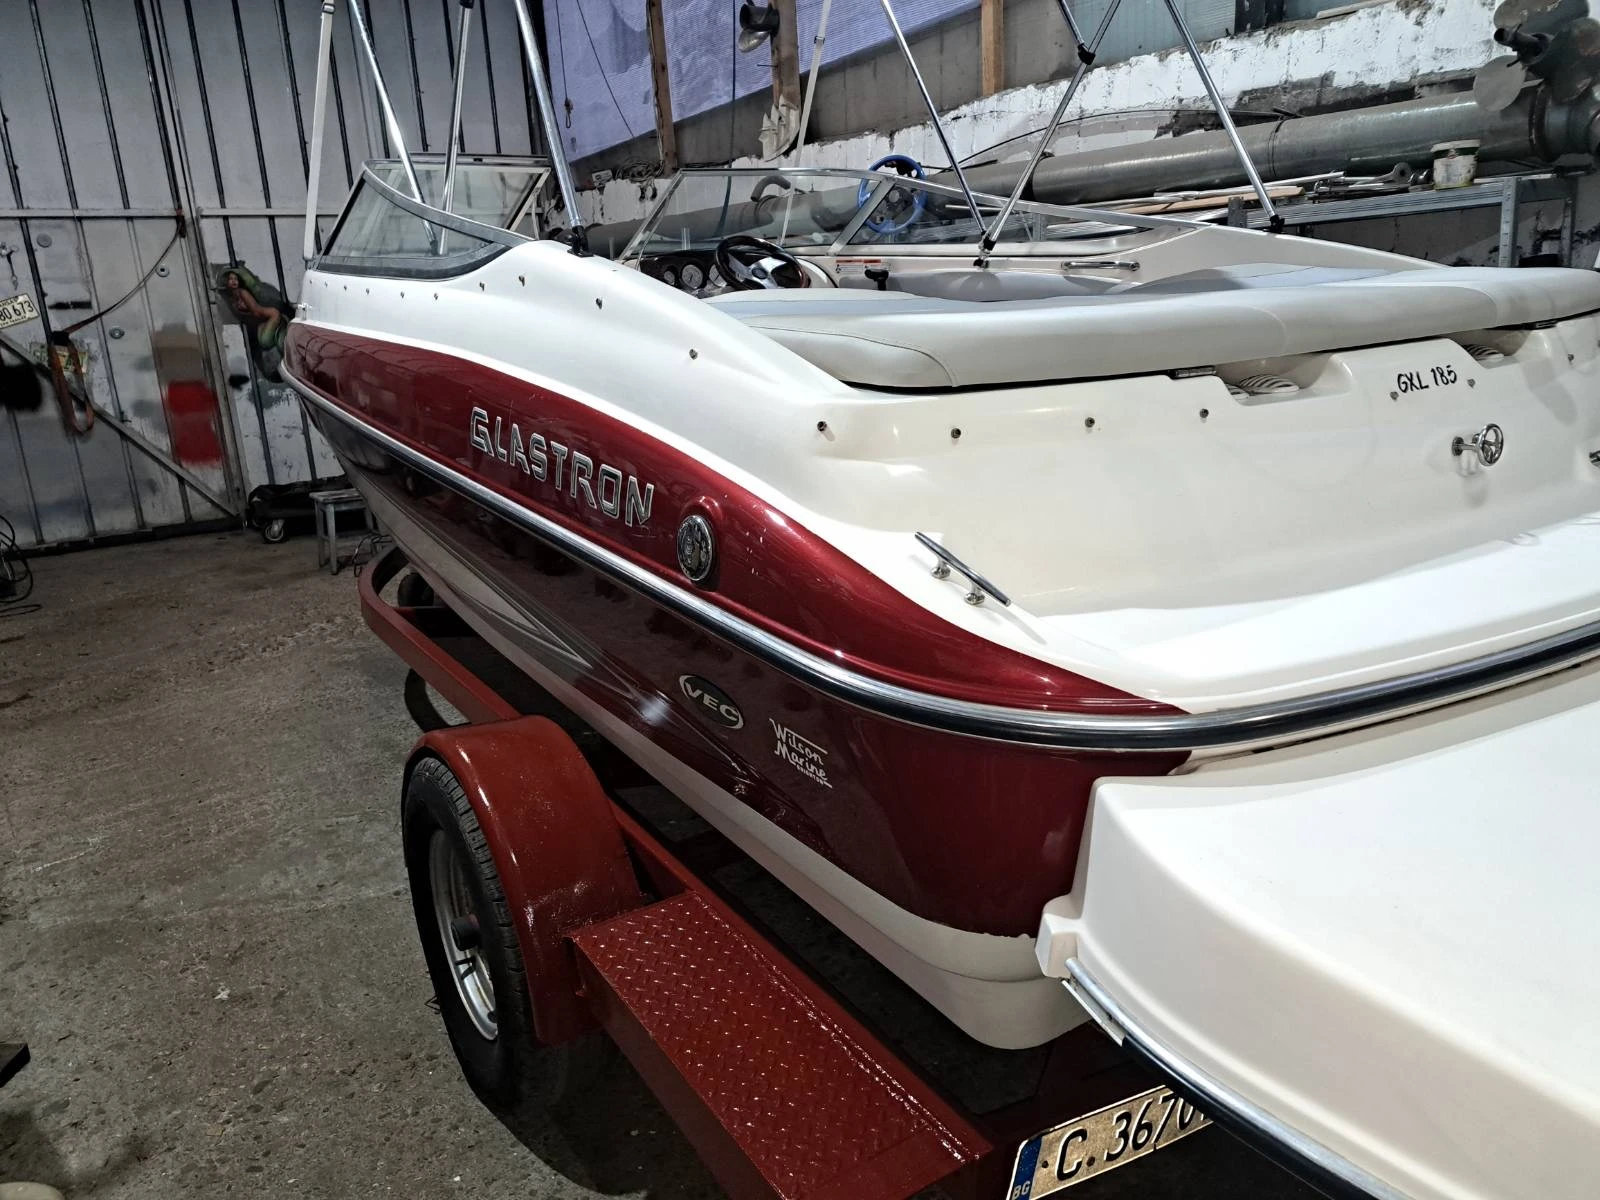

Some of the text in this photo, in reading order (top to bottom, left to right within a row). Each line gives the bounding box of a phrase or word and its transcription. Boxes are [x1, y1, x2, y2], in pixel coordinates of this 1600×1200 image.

[12, 300, 34, 316] 673
[1397, 365, 1458, 393] GXL 185
[470, 406, 655, 527] GLASTRON
[684, 682, 738, 721] VEC
[769, 718, 825, 766] Wilson
[774, 740, 828, 781] Marine
[1056, 1128, 1088, 1181] C
[1011, 1181, 1031, 1200] BG
